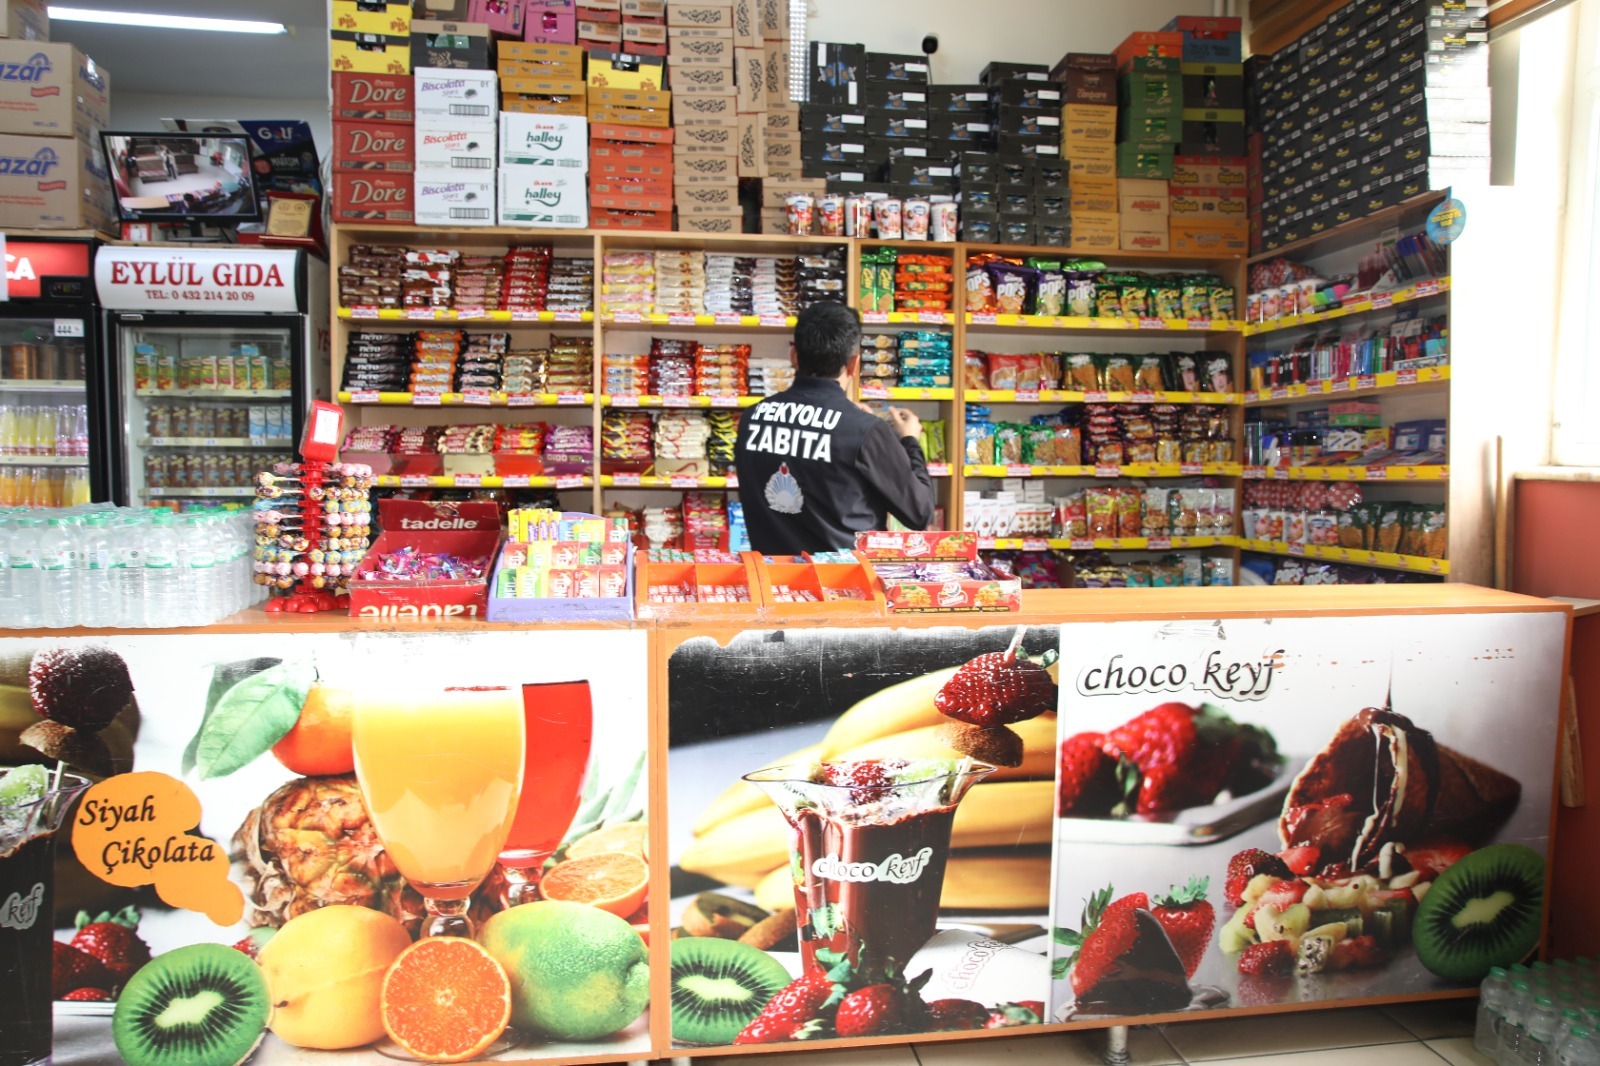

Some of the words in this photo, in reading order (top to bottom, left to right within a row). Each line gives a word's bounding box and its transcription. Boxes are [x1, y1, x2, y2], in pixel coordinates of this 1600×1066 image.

[0, 62, 52, 82] zar
[349, 79, 407, 104] Dore
[421, 80, 466, 92] Biscolata
[349, 130, 407, 154] Dore
[423, 132, 467, 145] Biscolata
[526, 131, 563, 151] halley
[349, 180, 407, 204] Dore
[421, 183, 466, 196] Biscolata
[524, 188, 562, 207] halley
[111, 256, 203, 286] EYLÜL
[212, 263, 285, 287] GIDA
[966, 272, 991, 292] OPS
[997, 282, 1026, 300] POPS
[1039, 278, 1066, 299] POPS
[145, 289, 169, 300] TEL:
[171, 290, 178, 300] 0
[182, 290, 201, 300] 432
[204, 290, 223, 300] 214
[226, 291, 239, 301] 20
[241, 291, 255, 301] 09
[1067, 284, 1097, 304] POPS
[751, 401, 842, 430] PEKYOLU
[746, 423, 832, 463] ZABITA
[400, 517, 478, 530] tadelle
[1084, 654, 1187, 690] choco
[1203, 649, 1285, 696] keyf
[79, 795, 156, 832] Siyah
[102, 836, 216, 875] Çikolata
[818, 856, 875, 878] choco
[885, 850, 929, 879] keyf
